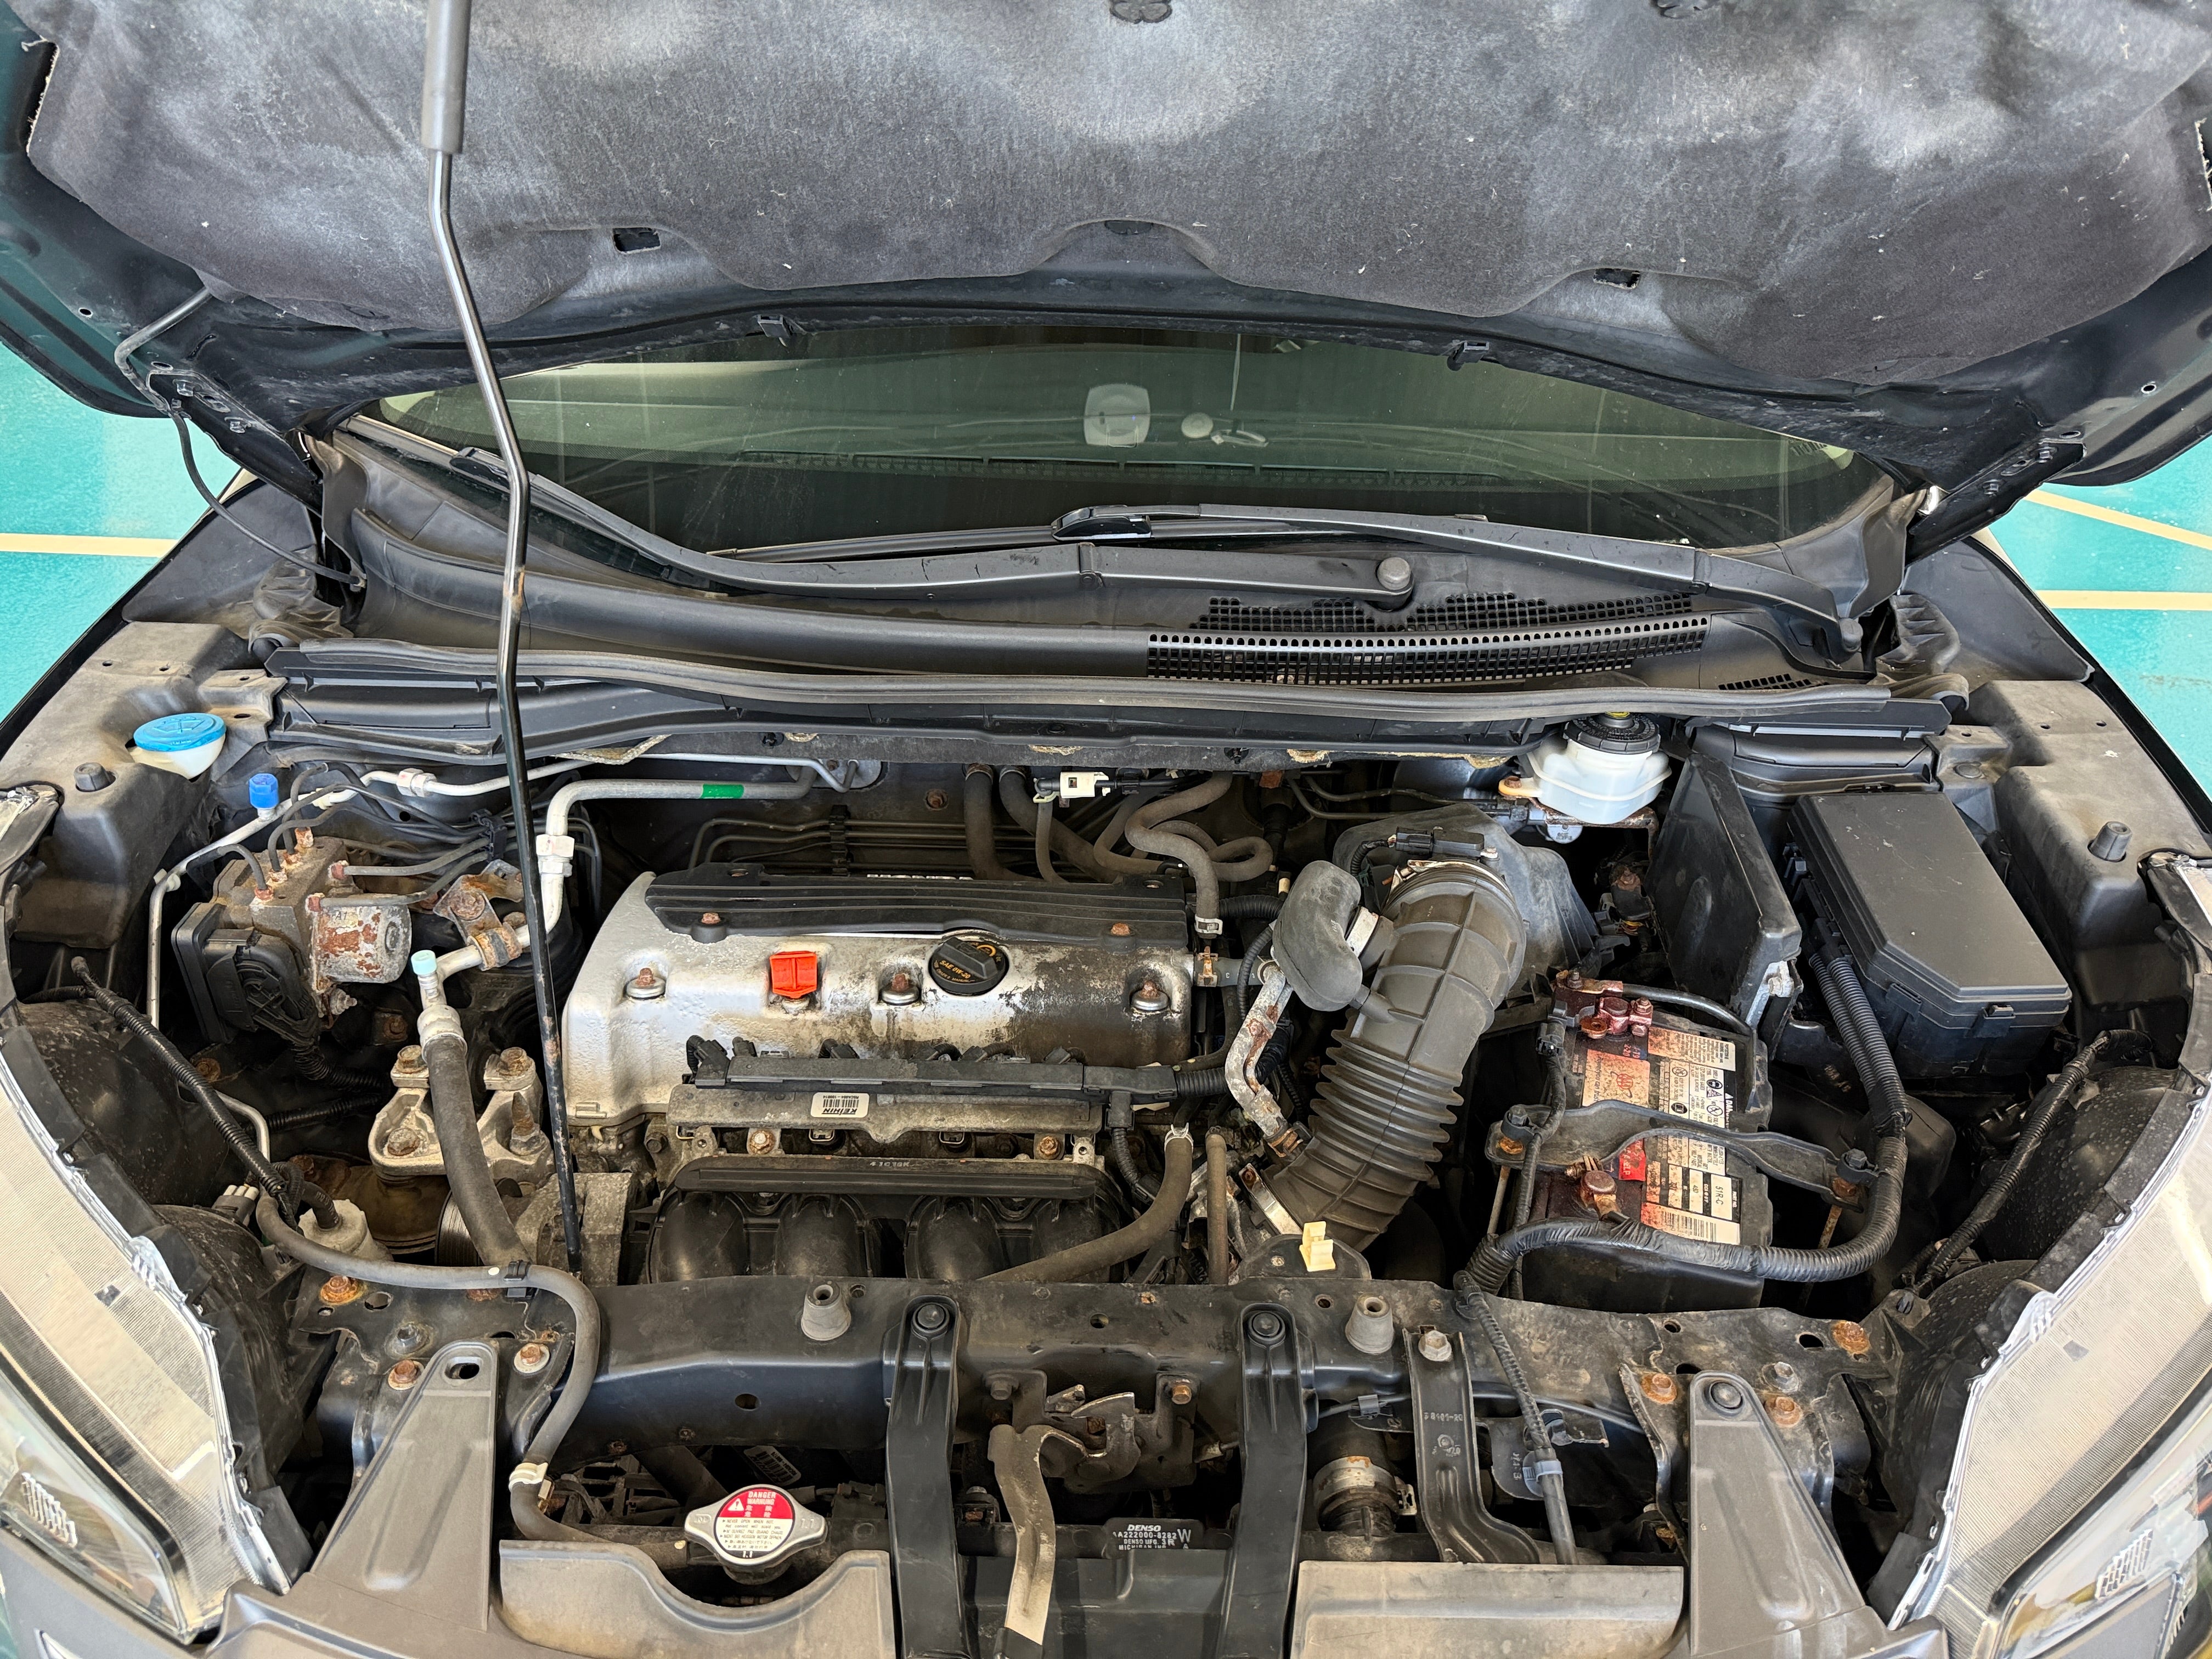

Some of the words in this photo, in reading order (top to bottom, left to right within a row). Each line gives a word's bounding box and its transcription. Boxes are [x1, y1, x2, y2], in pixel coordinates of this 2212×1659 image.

[940, 960, 953, 969] SAE
[952, 967, 971, 979] 0W-20
[1715, 1186, 1723, 1205] 51R-C
[1177, 1528, 1191, 1543] W
